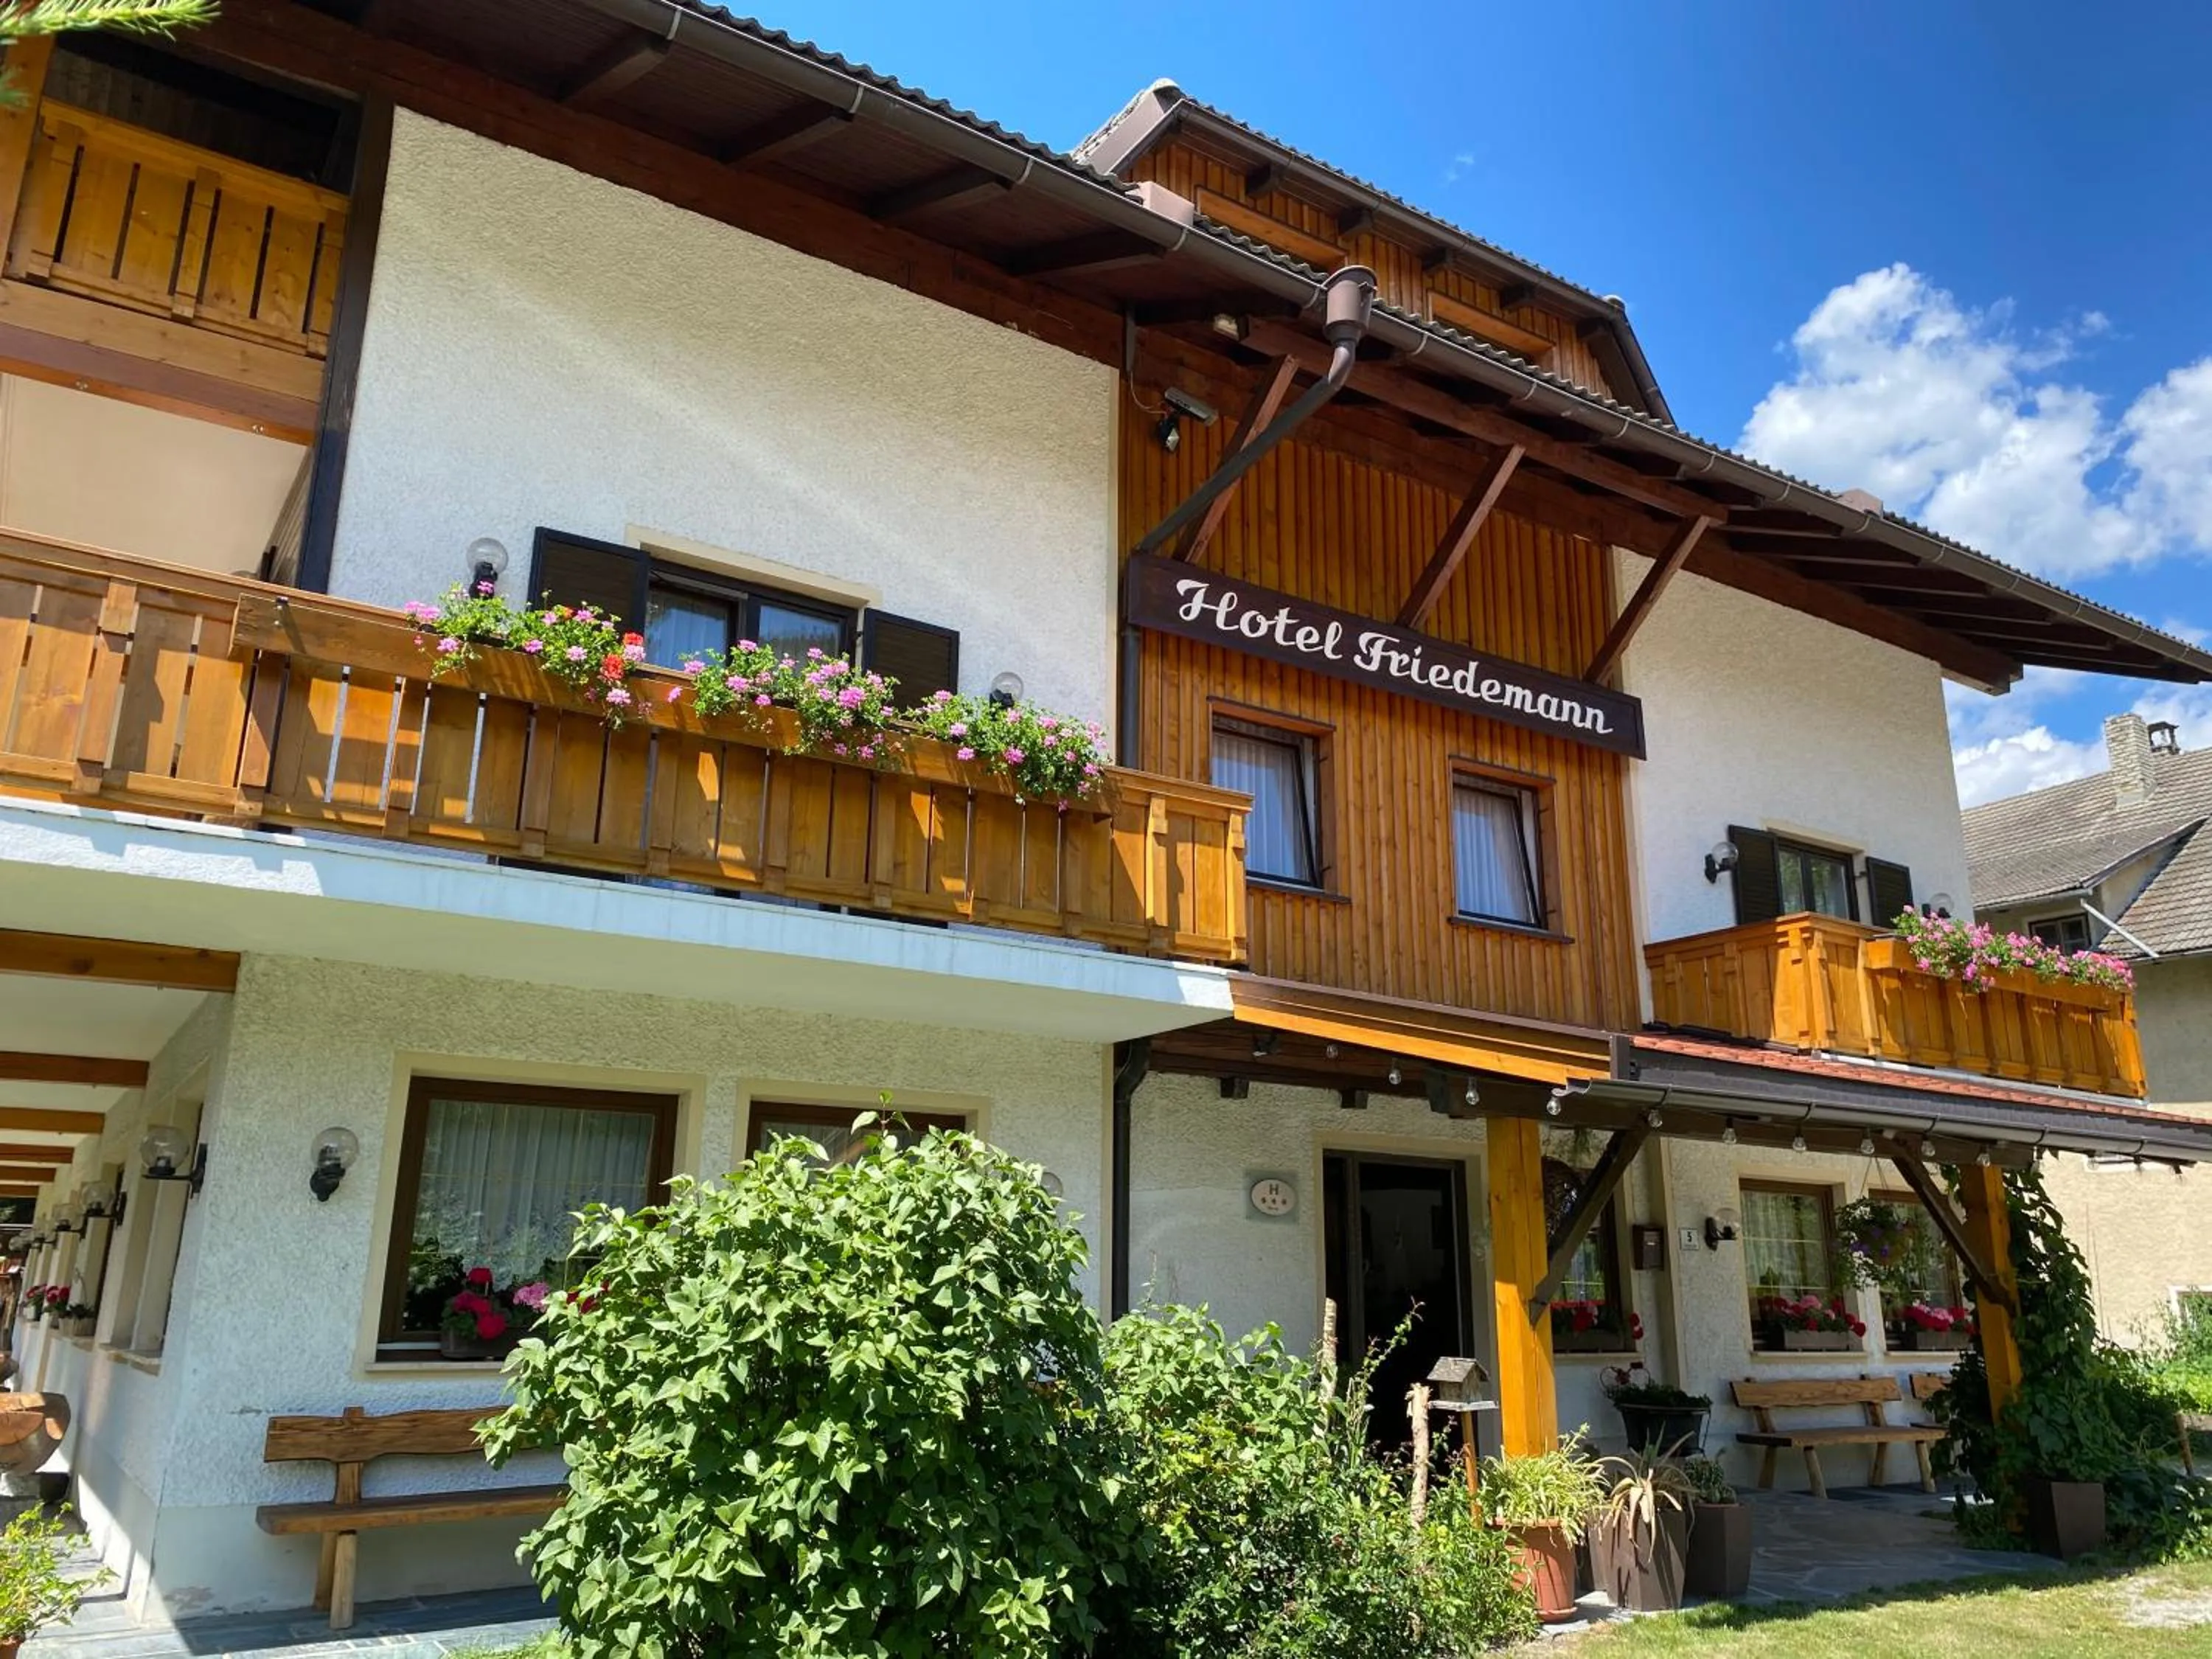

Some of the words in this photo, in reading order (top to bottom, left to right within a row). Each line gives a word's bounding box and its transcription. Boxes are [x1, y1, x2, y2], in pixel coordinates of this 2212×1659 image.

[1176, 579, 1343, 660] Hotel
[1354, 632, 1613, 734] Friedemann
[1269, 1183, 1279, 1195] H
